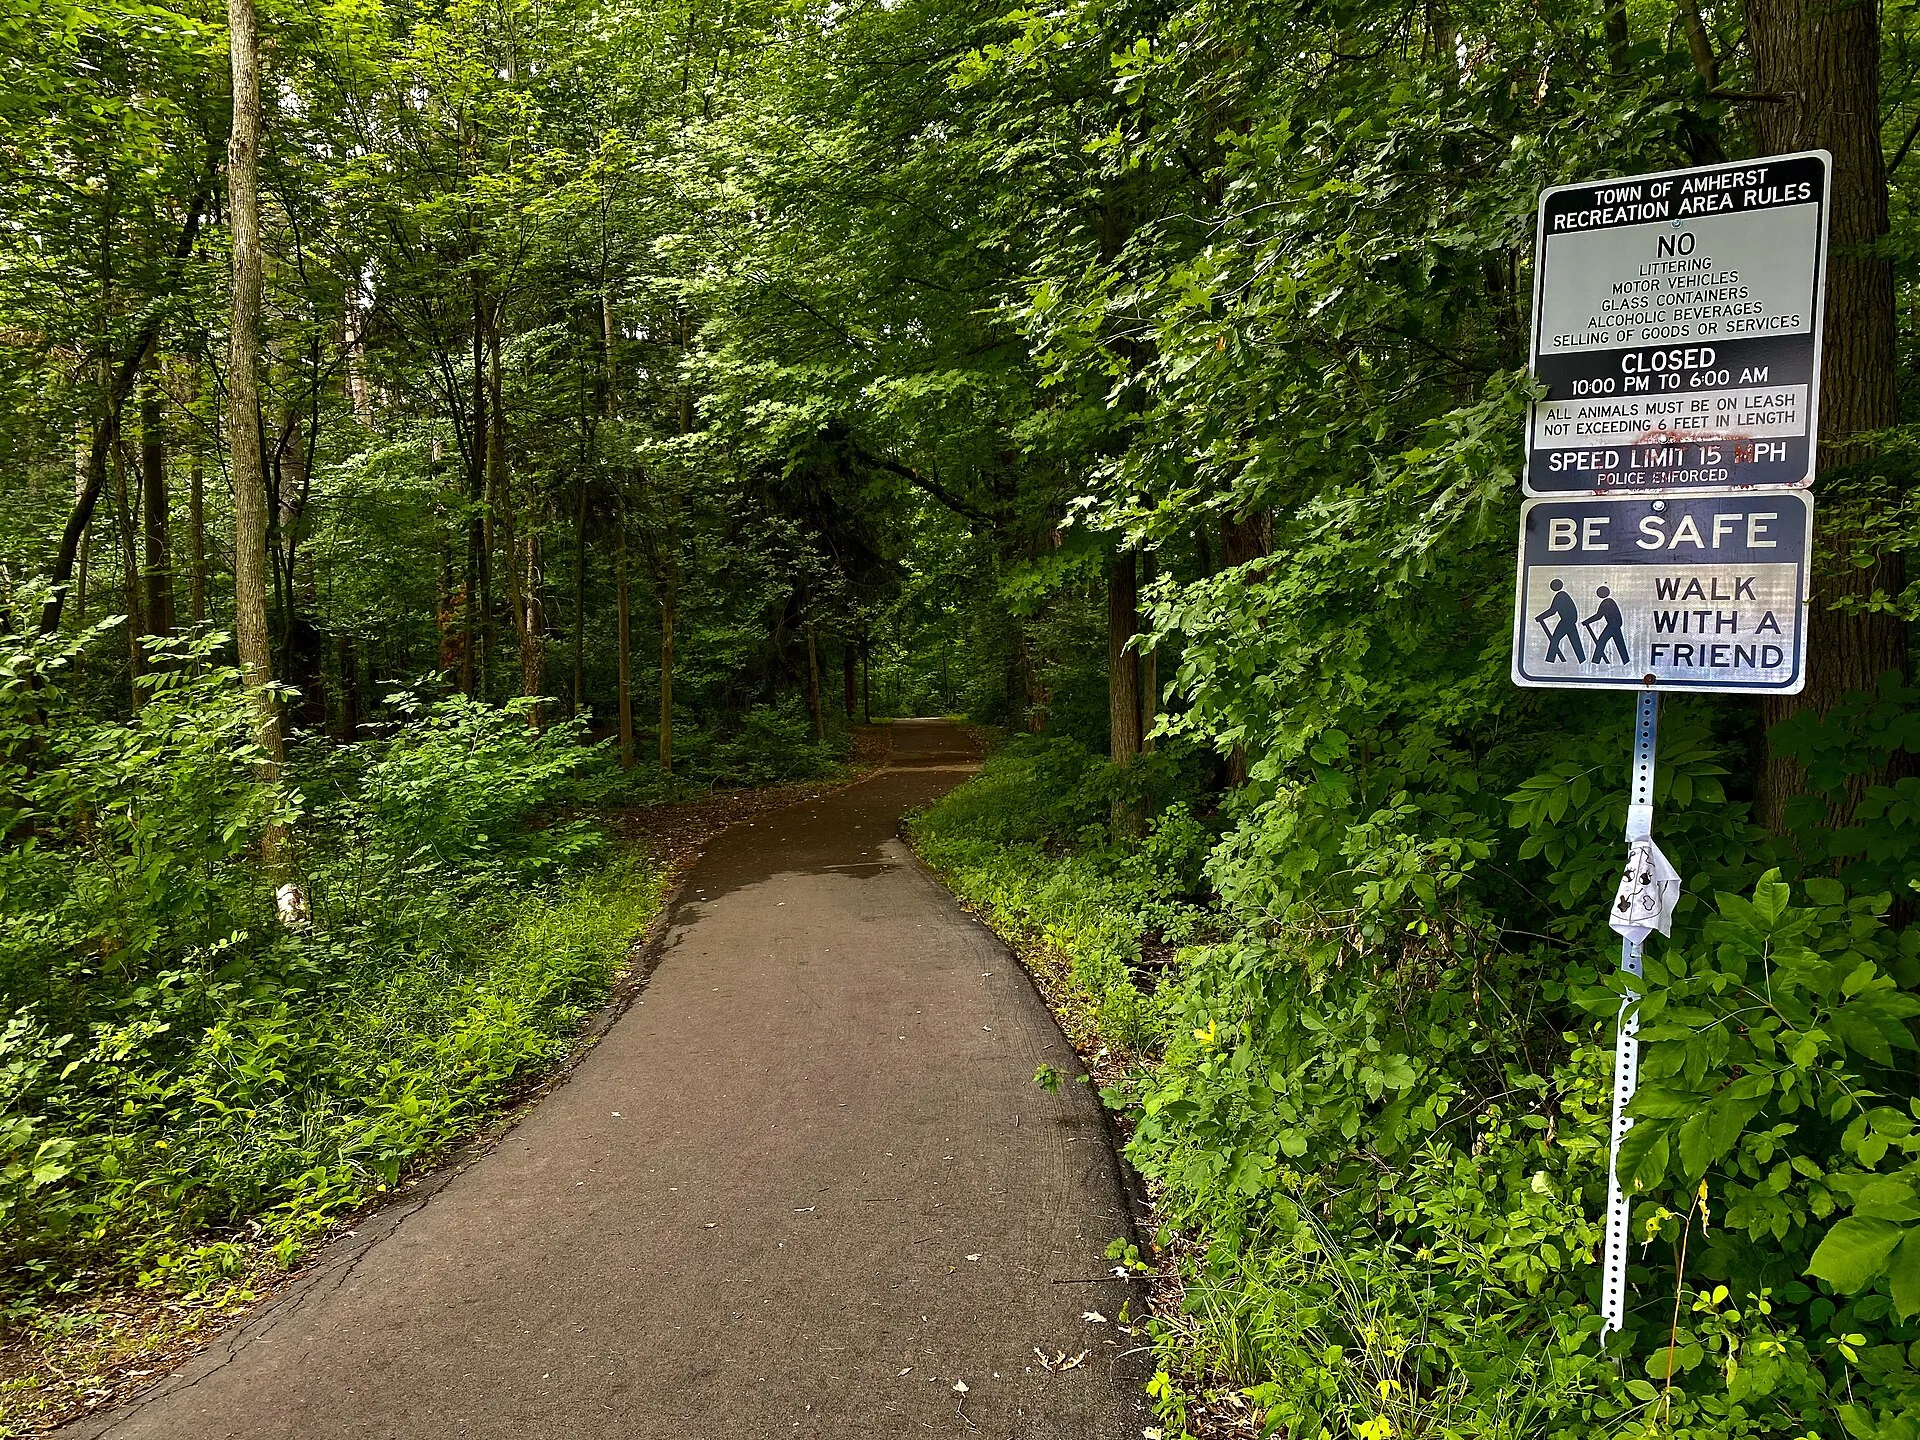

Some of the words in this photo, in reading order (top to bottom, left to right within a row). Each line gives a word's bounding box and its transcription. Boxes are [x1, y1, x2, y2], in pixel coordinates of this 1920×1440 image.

[1595, 186, 1642, 205] TOWN
[1650, 181, 1673, 198] OF
[1681, 168, 1768, 194] AMHERST
[1554, 201, 1669, 231] RECREATION
[1678, 192, 1733, 215] AREA
[1744, 183, 1811, 206] RULES
[1657, 232, 1695, 258] NO
[1639, 258, 1712, 276] LITTERING
[1612, 279, 1660, 295] MOTOR
[1668, 271, 1739, 288] VEHICLES
[1602, 296, 1649, 311] GLASS
[1656, 287, 1749, 306] CONTAINERS
[1588, 310, 1666, 328] ALCOHOLIC
[1674, 302, 1762, 321] BEVERAGES
[1553, 332, 1609, 347] SELLING
[1617, 329, 1634, 341] OF
[1641, 324, 1690, 340] GOODS
[1698, 322, 1718, 335] OR
[1725, 315, 1800, 333] SERVICES
[1622, 348, 1716, 374] CLOSED
[1572, 377, 1615, 395] 10:00
[1624, 375, 1649, 392] PM
[1658, 372, 1681, 389] TO
[1690, 370, 1730, 387] 6:00
[1739, 367, 1769, 384] AM
[1546, 408, 1571, 420] ALL
[1578, 404, 1639, 418] ANIMALS
[1645, 400, 1683, 415] MUST
[1691, 399, 1709, 412] BE
[1717, 397, 1737, 410] ON
[1745, 394, 1795, 408] LEASH
[1544, 423, 1569, 436] NOT
[1576, 418, 1651, 435] EXCEEDING
[1658, 418, 1667, 430] 6
[1674, 416, 1708, 429] FEET
[1716, 415, 1730, 427] IN
[1737, 411, 1795, 426] LENGTH
[1549, 450, 1619, 472] SPEED
[1631, 447, 1686, 468] LIMIT
[1700, 445, 1722, 465] 15
[1734, 442, 1786, 464] MPH
[1597, 472, 1645, 485] POLICE
[1653, 469, 1728, 483] ENFORCED
[1548, 517, 1610, 551] BE
[1636, 513, 1778, 550] SAFE
[1655, 576, 1757, 600] WALK
[1654, 610, 1737, 634] WITH
[1755, 610, 1781, 634] A
[1650, 643, 1783, 669] FRIEND
